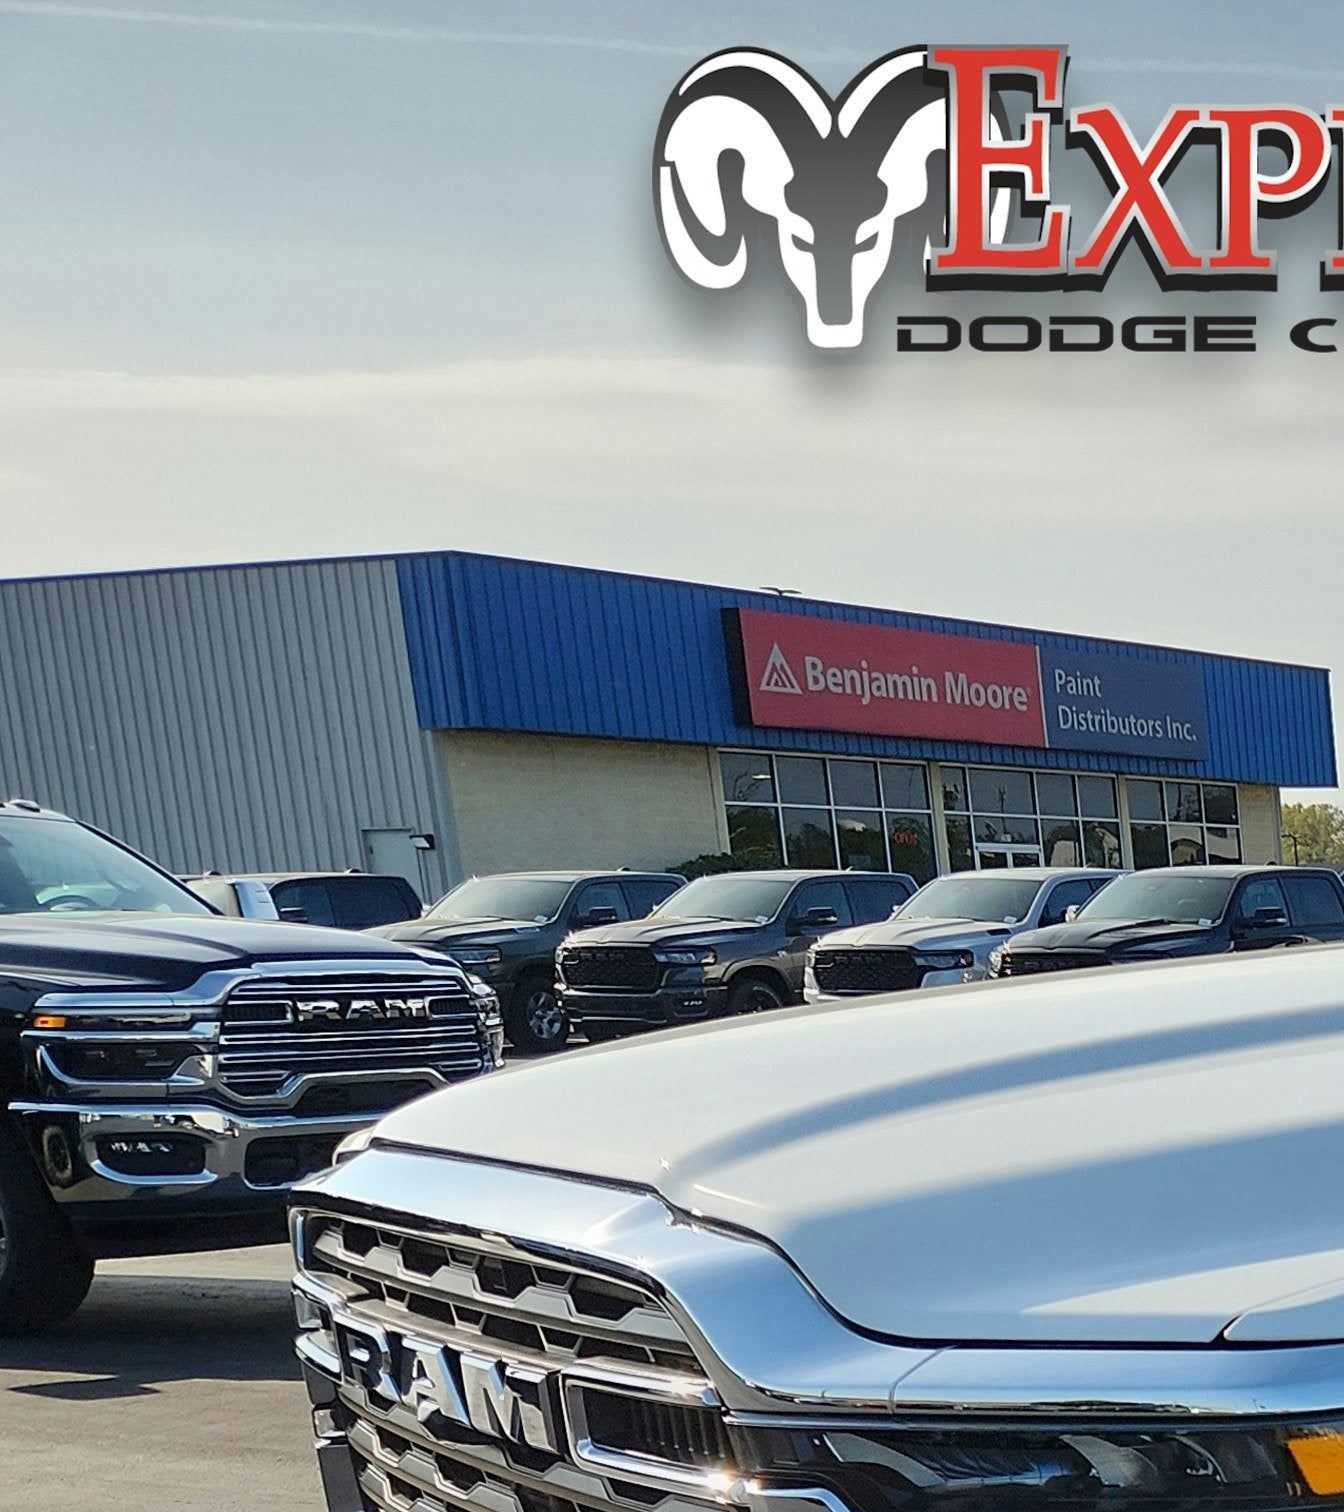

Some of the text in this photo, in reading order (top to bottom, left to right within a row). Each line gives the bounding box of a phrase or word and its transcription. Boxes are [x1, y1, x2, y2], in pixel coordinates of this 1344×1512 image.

[804, 655, 1028, 712] Benjamin Moore
[1054, 668, 1102, 698] Paint
[1057, 704, 1197, 742] Distributors Inc.
[296, 998, 425, 1021] RAM
[333, 1311, 561, 1456] RAM
